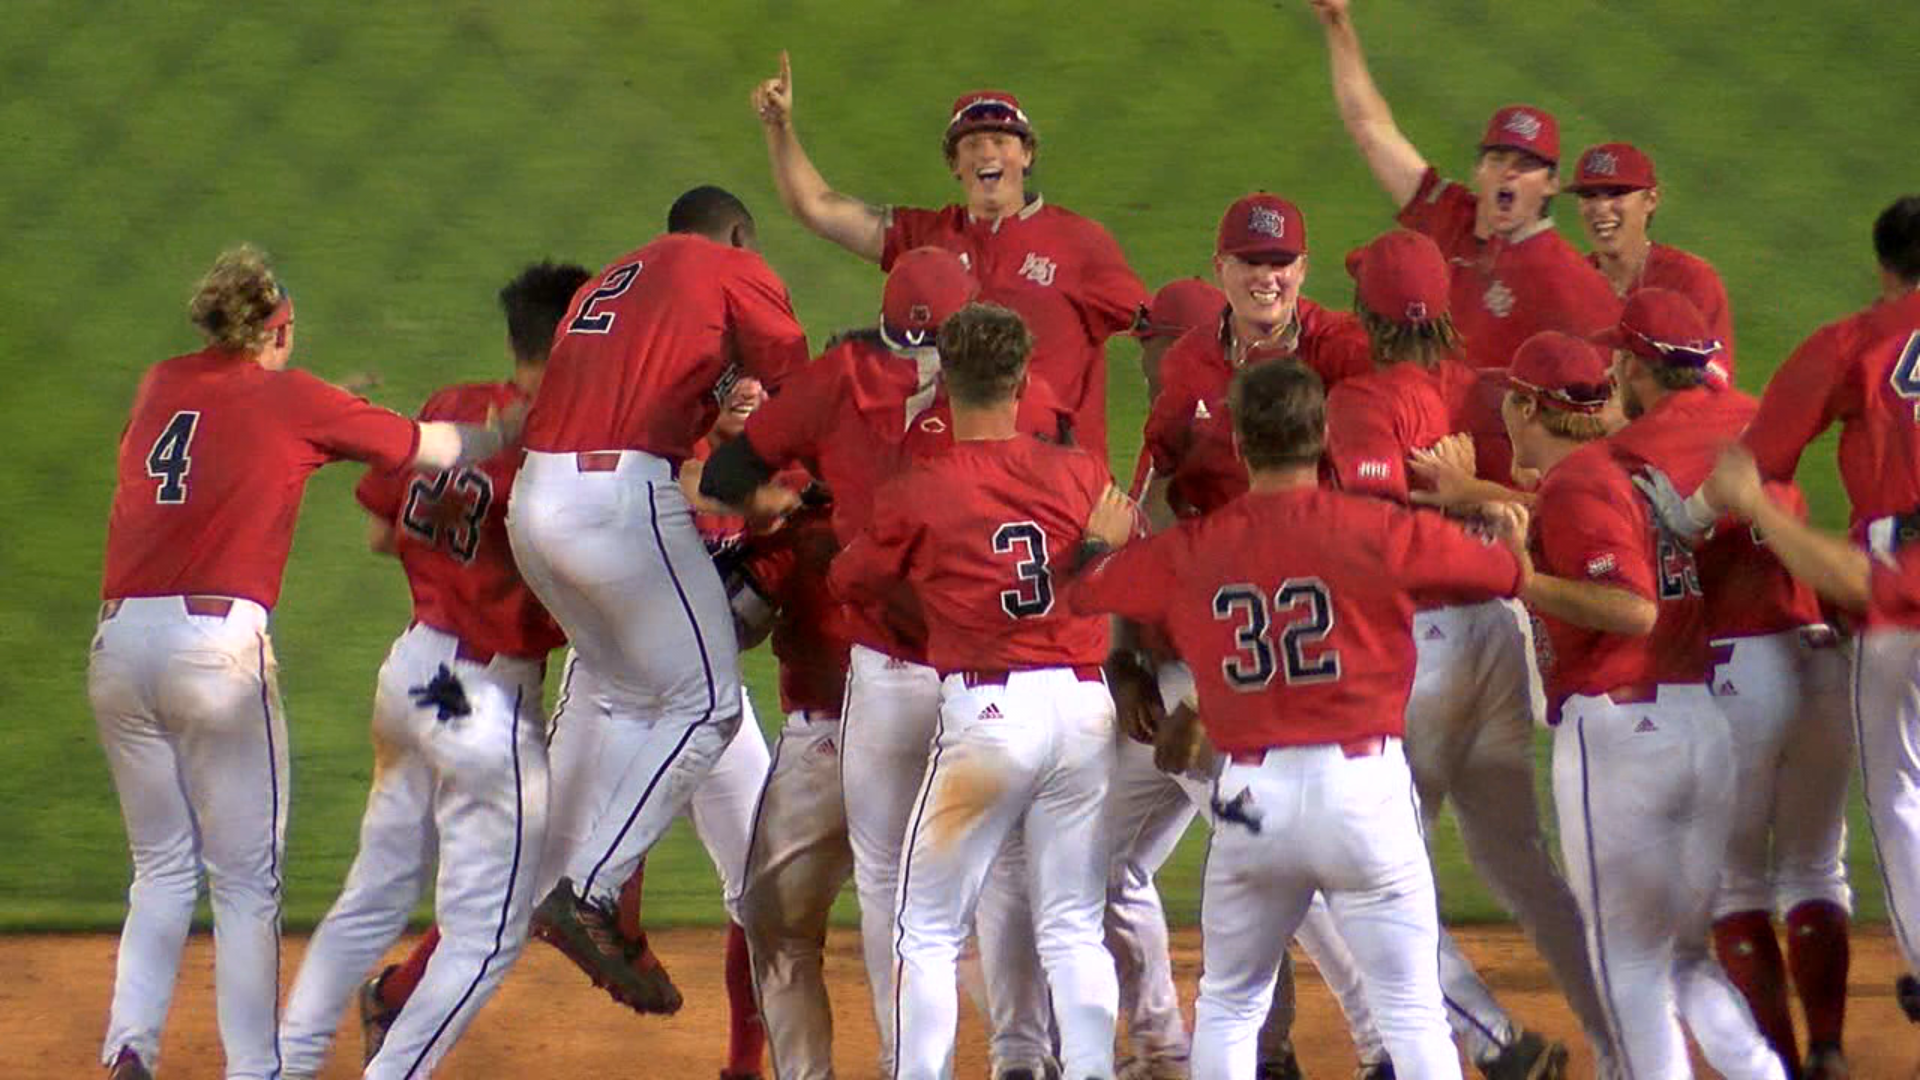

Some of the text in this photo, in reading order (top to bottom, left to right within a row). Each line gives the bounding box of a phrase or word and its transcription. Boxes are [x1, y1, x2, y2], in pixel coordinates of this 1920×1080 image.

[567, 260, 643, 334] 2
[145, 408, 201, 504] 4
[402, 466, 493, 566] 23
[992, 520, 1055, 620] 3
[1213, 576, 1341, 690] 32
